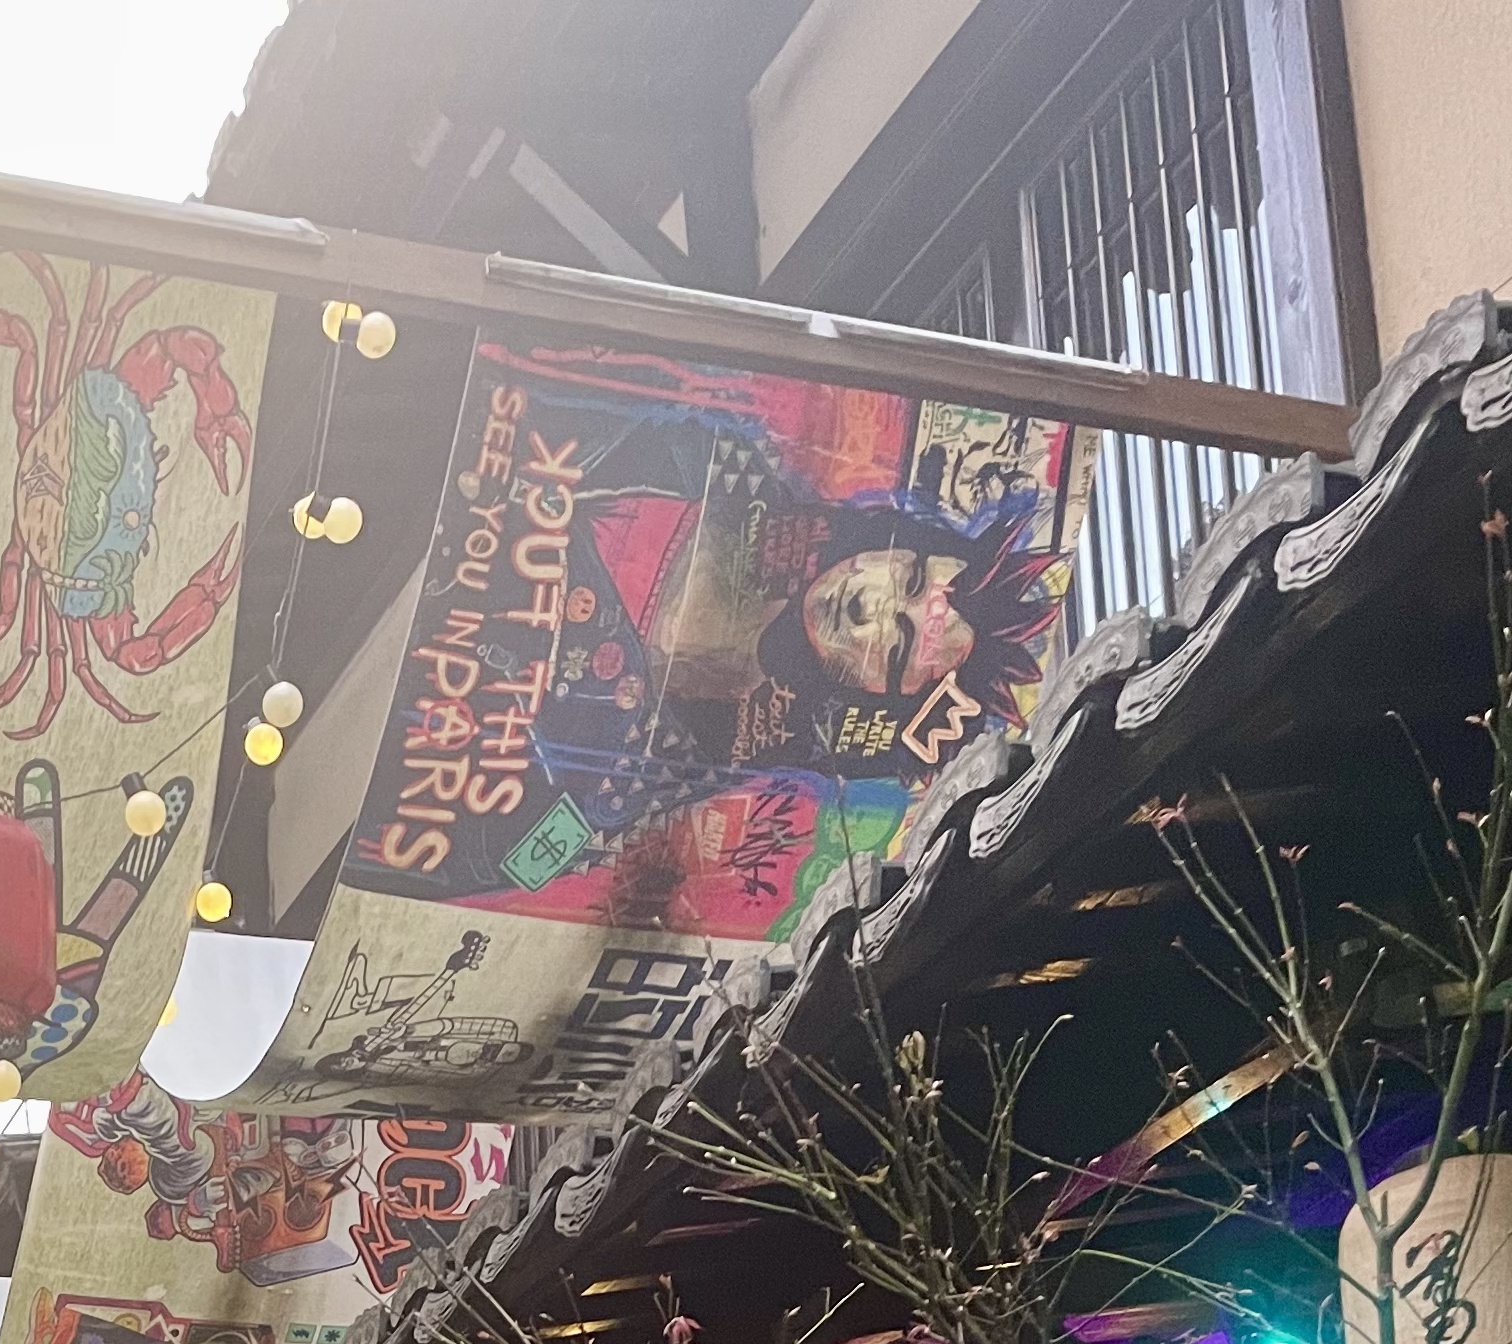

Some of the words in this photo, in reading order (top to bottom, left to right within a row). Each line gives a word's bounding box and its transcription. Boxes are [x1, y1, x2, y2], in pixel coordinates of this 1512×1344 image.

[477, 385, 526, 480] SEE
[452, 500, 507, 590] YOU
[439, 609, 486, 649] IN
[462, 661, 553, 816] THIS
[835, 707, 859, 754] RULES
[852, 721, 870, 744] THE
[861, 710, 886, 757] WRITE
[878, 721, 896, 751] YOU
[375, 649, 479, 874] PARIS
